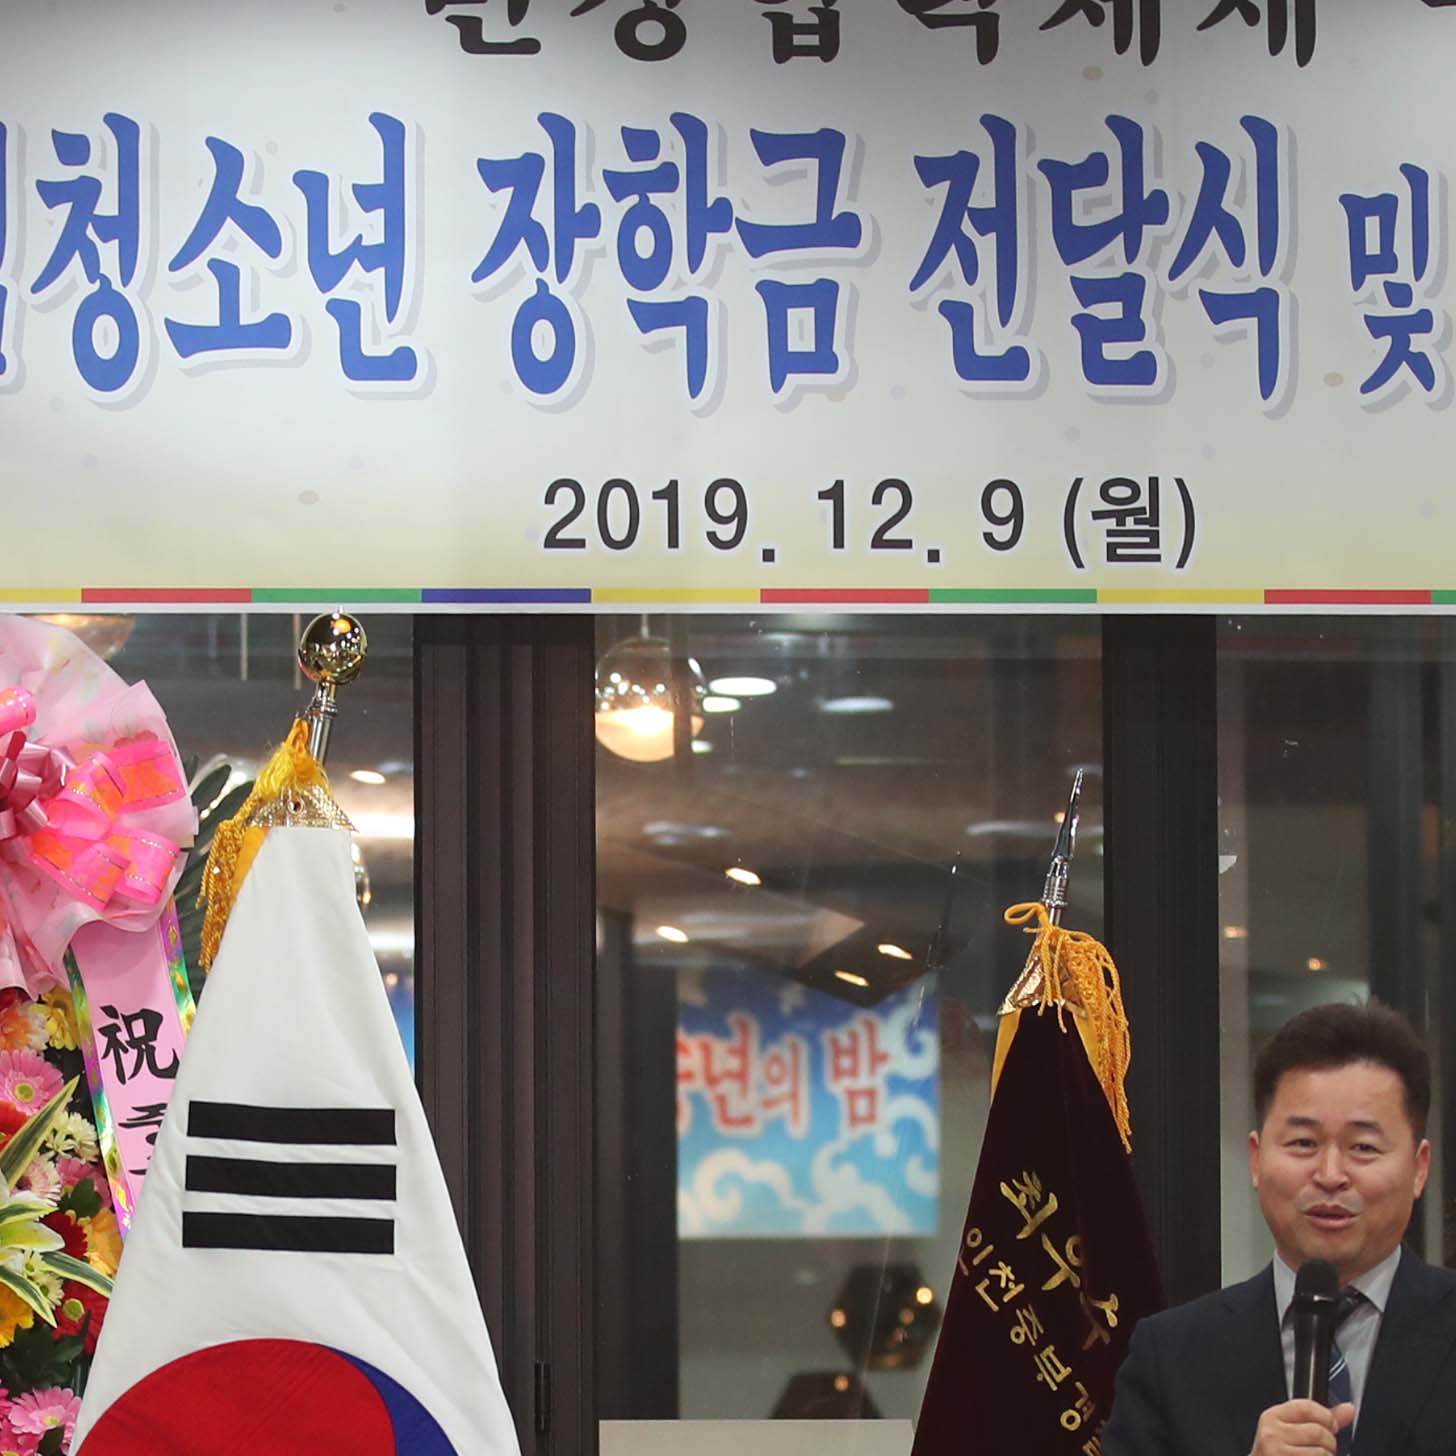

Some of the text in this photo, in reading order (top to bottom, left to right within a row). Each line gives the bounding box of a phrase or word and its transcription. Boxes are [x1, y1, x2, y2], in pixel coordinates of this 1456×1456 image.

[472, 112, 862, 397] 장학금
[911, 114, 1281, 400] 전달식
[1340, 164, 1437, 394] 및
[543, 476, 1197, 569] 2019. 12. 9 (월)
[98, 1005, 180, 1085] 祝
[828, 1016, 889, 1128] 밤
